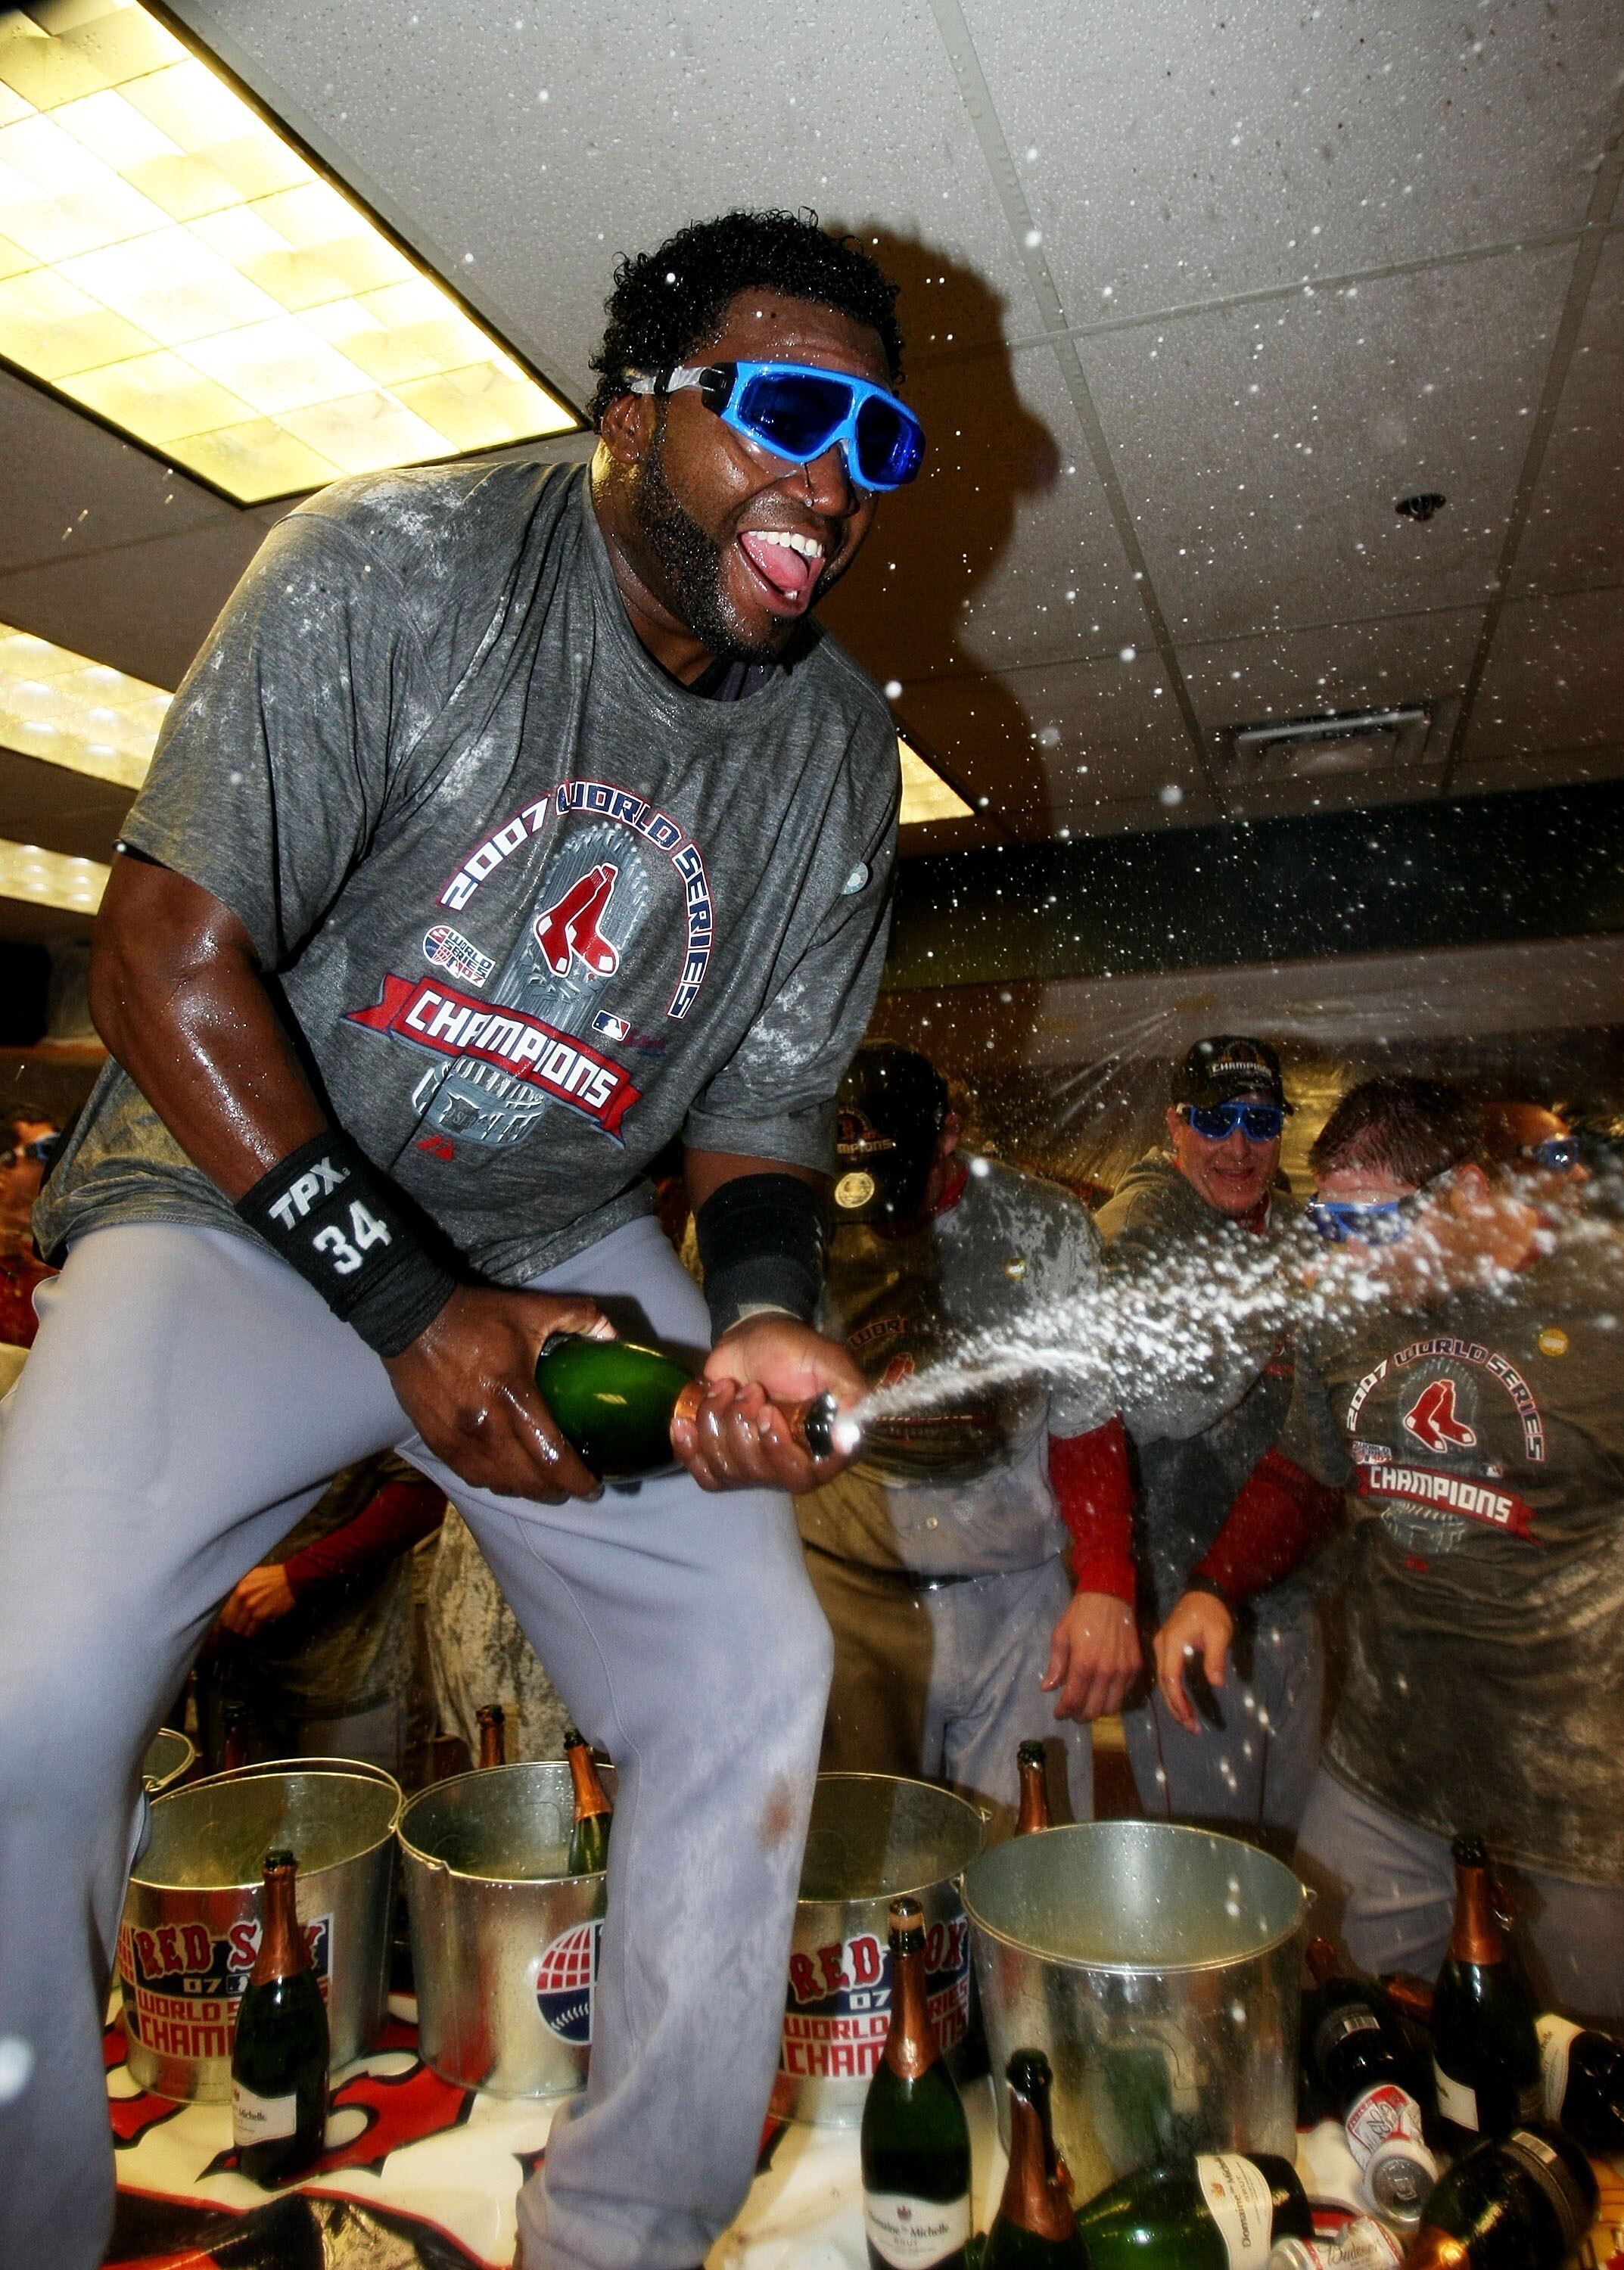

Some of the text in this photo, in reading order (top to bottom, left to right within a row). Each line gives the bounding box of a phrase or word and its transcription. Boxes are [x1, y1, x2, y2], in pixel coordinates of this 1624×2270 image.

[440, 780, 713, 1019] 2007 WORLD SERIES
[443, 938, 488, 979] SERIES
[447, 931, 492, 969] WORLD
[405, 988, 619, 1109] CHAMPIONS
[269, 1156, 347, 1230] TPX
[313, 1199, 393, 1274] 34
[1346, 1338, 1545, 1461] 2007 WORLD SERIES
[1370, 1466, 1513, 1523] CHAMPIONS
[134, 1923, 213, 1979] RED
[790, 1922, 966, 2001] RED OX
[138, 1989, 220, 2021] WORLD
[184, 1978, 222, 1994] 07
[850, 1989, 891, 2010] 07
[141, 2013, 235, 2057] CHAM
[784, 2015, 889, 2040] WORLD
[910, 2222, 950, 2238] Michelle
[1234, 2194, 1251, 2248] Domaine
